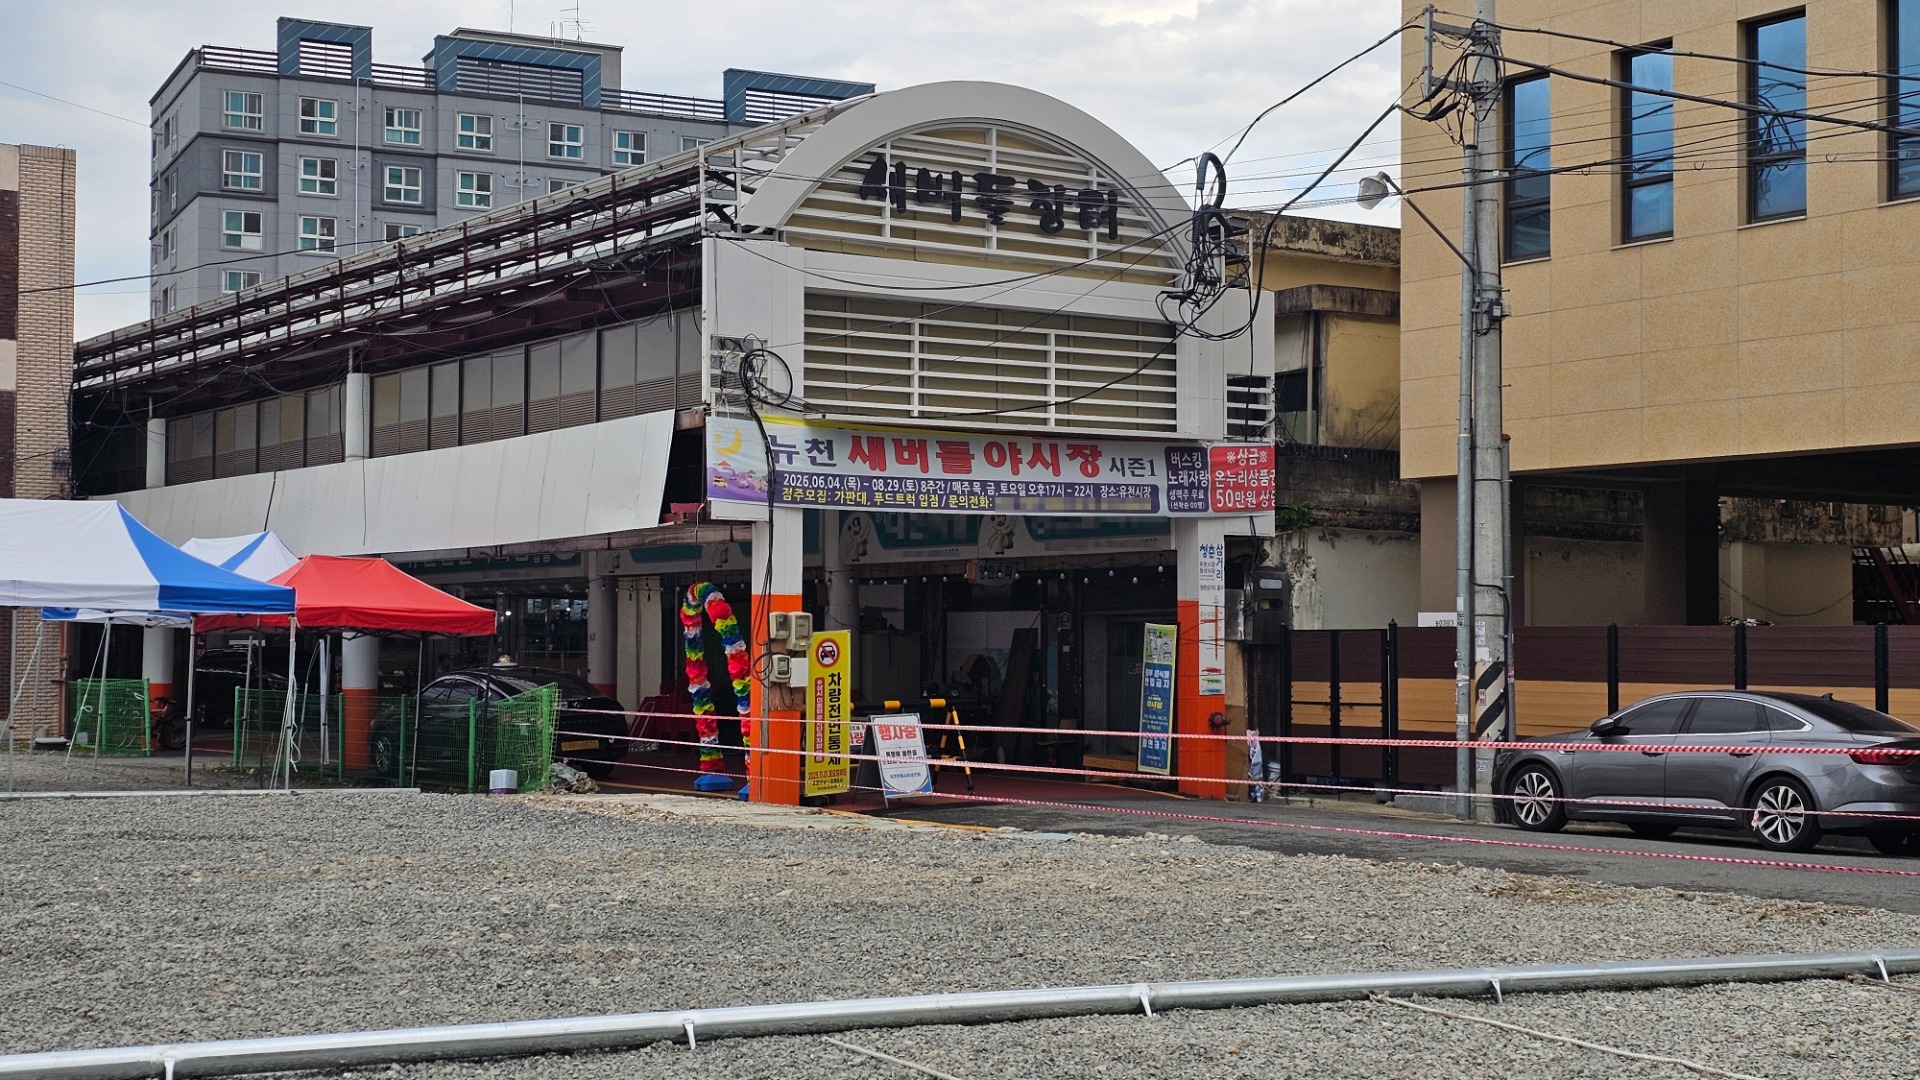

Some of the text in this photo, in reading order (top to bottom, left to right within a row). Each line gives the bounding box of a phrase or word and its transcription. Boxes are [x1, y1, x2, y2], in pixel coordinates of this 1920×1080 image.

[859, 155, 1119, 240] 새버들장터
[768, 435, 1157, 478] 뉴천 새버들야시장 시즌1
[1171, 452, 1202, 468] 버스킹
[783, 474, 860, 491] 2026.06.04.(목)
[872, 479, 918, 493] 08.29.(토)
[920, 481, 945, 494] 8주간
[952, 482, 970, 494] 매주
[1000, 482, 1026, 496] 토요일
[1074, 485, 1094, 498] 22시
[1168, 470, 1209, 487] 노래자랑
[782, 487, 831, 504] 점주모집:
[834, 490, 870, 506] 가판대,
[873, 492, 915, 507] 푸드트럭
[919, 493, 939, 508] 입점
[948, 496, 993, 509] 문의전화:
[1169, 489, 1206, 501] 생맥주 무료
[1216, 489, 1257, 508] 50만원
[1199, 543, 1215, 559] 청춘
